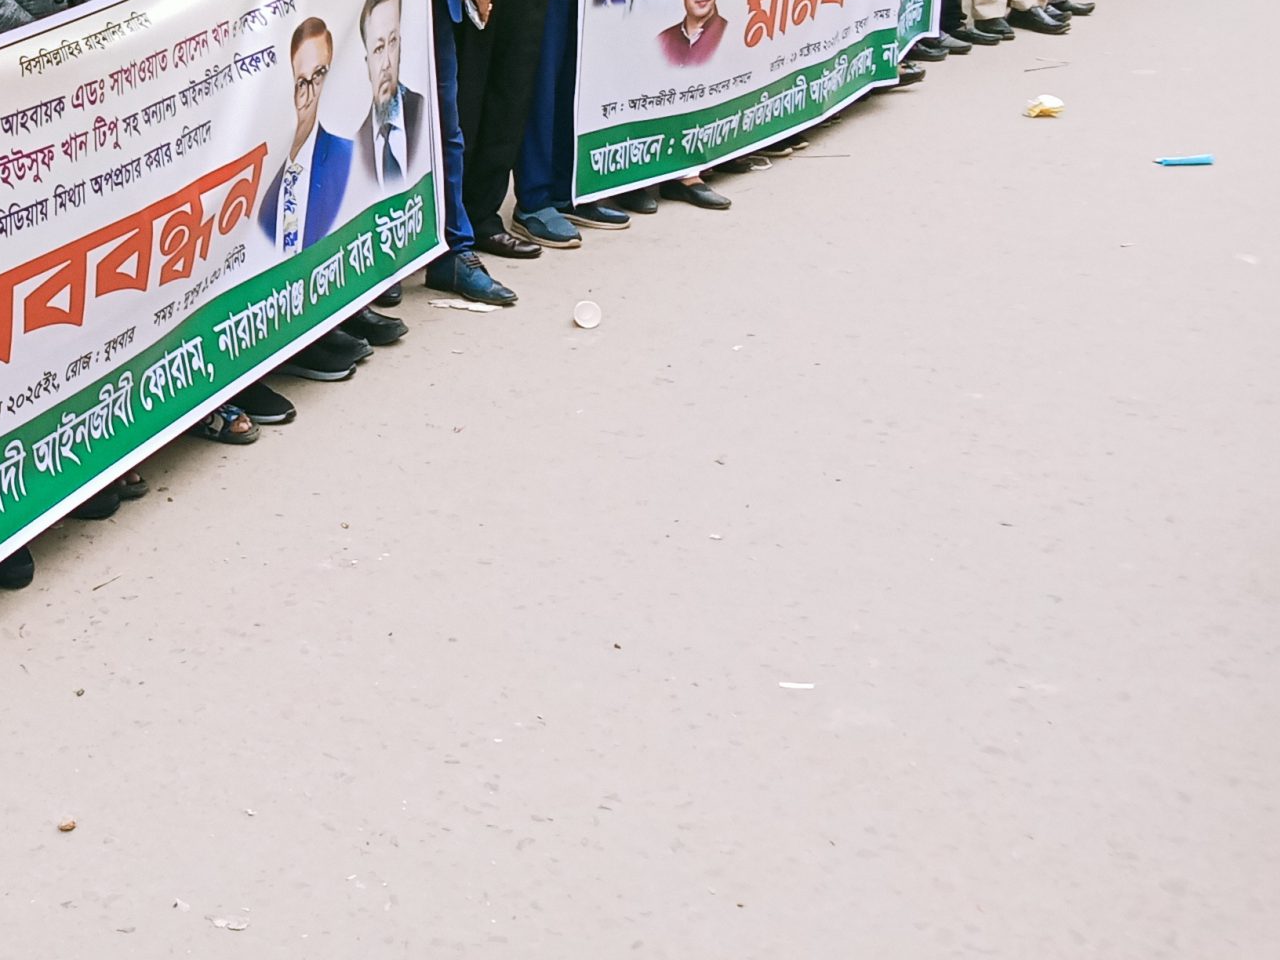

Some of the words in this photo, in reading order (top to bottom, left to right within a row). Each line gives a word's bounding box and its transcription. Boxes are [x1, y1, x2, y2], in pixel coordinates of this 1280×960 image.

[71, 77, 106, 111] এডঃ
[108, 48, 169, 97] সাখাওয়াত
[172, 30, 210, 70] হোসেন
[628, 89, 676, 112] আইনজীবী
[61, 130, 90, 164] খান
[93, 115, 122, 152] টিপু
[122, 111, 142, 138] সহ
[141, 93, 177, 125] অন্যান্য
[589, 133, 666, 176] আয়োজনে
[681, 109, 741, 156] বাংলাদেশ
[53, 178, 87, 217] মিথ্যা
[90, 156, 142, 197] অপপ্রচার
[144, 141, 173, 172] করার
[175, 119, 212, 156] প্রতিবাদে
[31, 371, 136, 477] আইনজীবী
[138, 335, 216, 413] ফোরাম,
[212, 277, 305, 361] নারায়ণগঞ্জ
[308, 245, 346, 306] জেলা
[347, 230, 376, 277] বার
[375, 193, 425, 261] ইউনিট
[65, 347, 94, 383] রোজ
[103, 324, 137, 363] বুধবার
